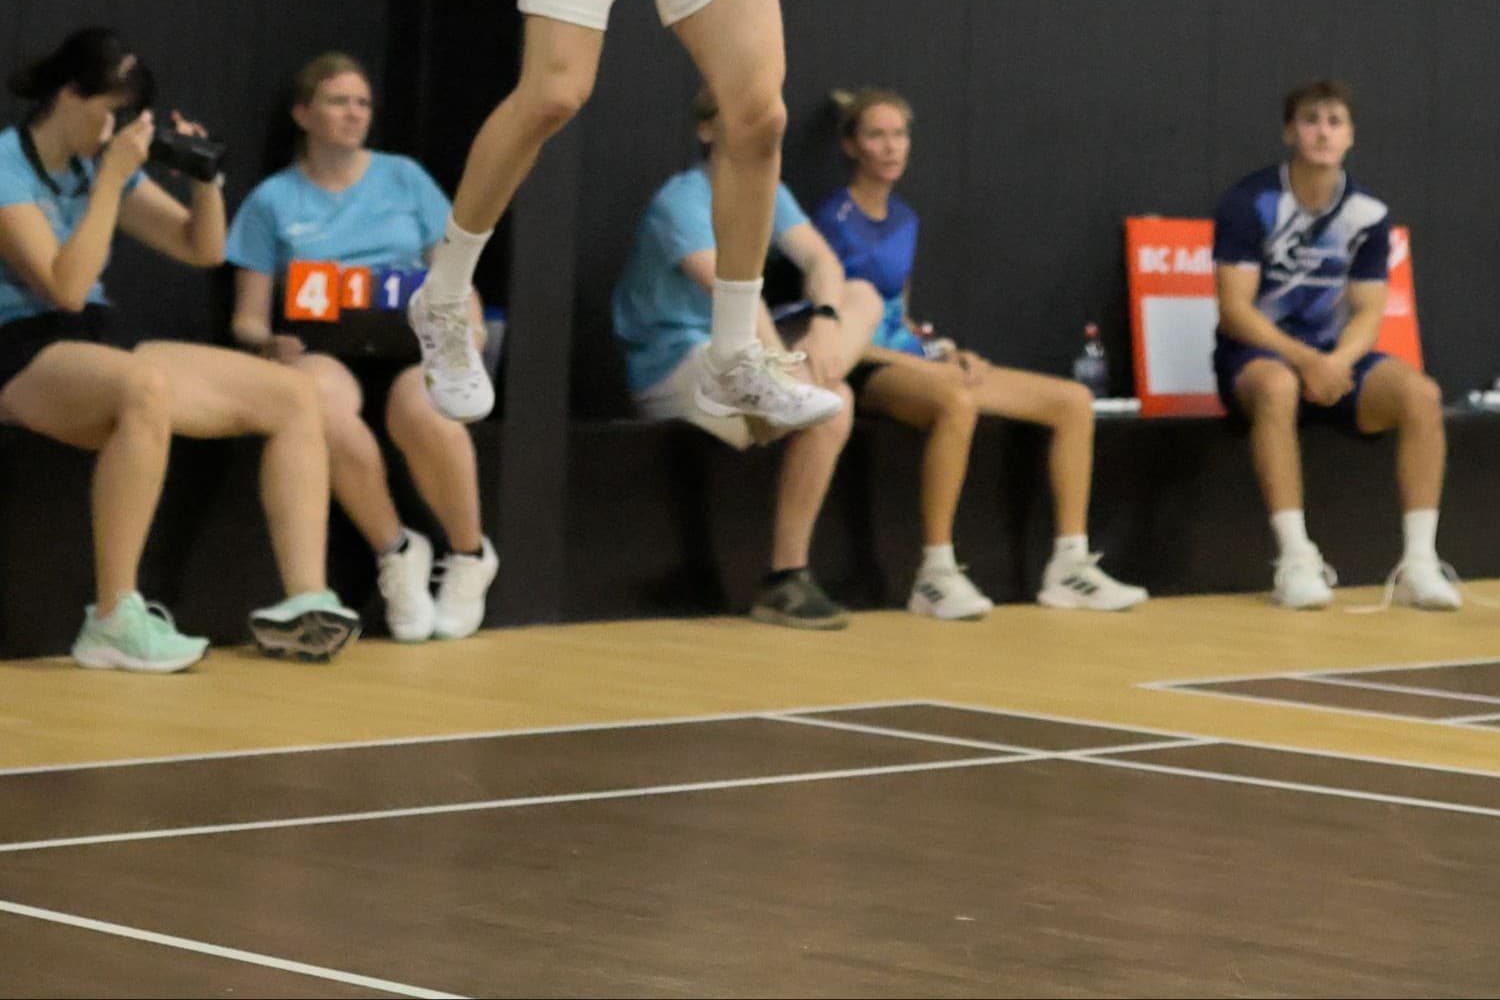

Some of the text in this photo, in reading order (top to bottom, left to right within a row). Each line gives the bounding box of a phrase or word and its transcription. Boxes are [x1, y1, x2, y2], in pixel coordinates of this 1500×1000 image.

[296, 271, 401, 317] 4 1 1
